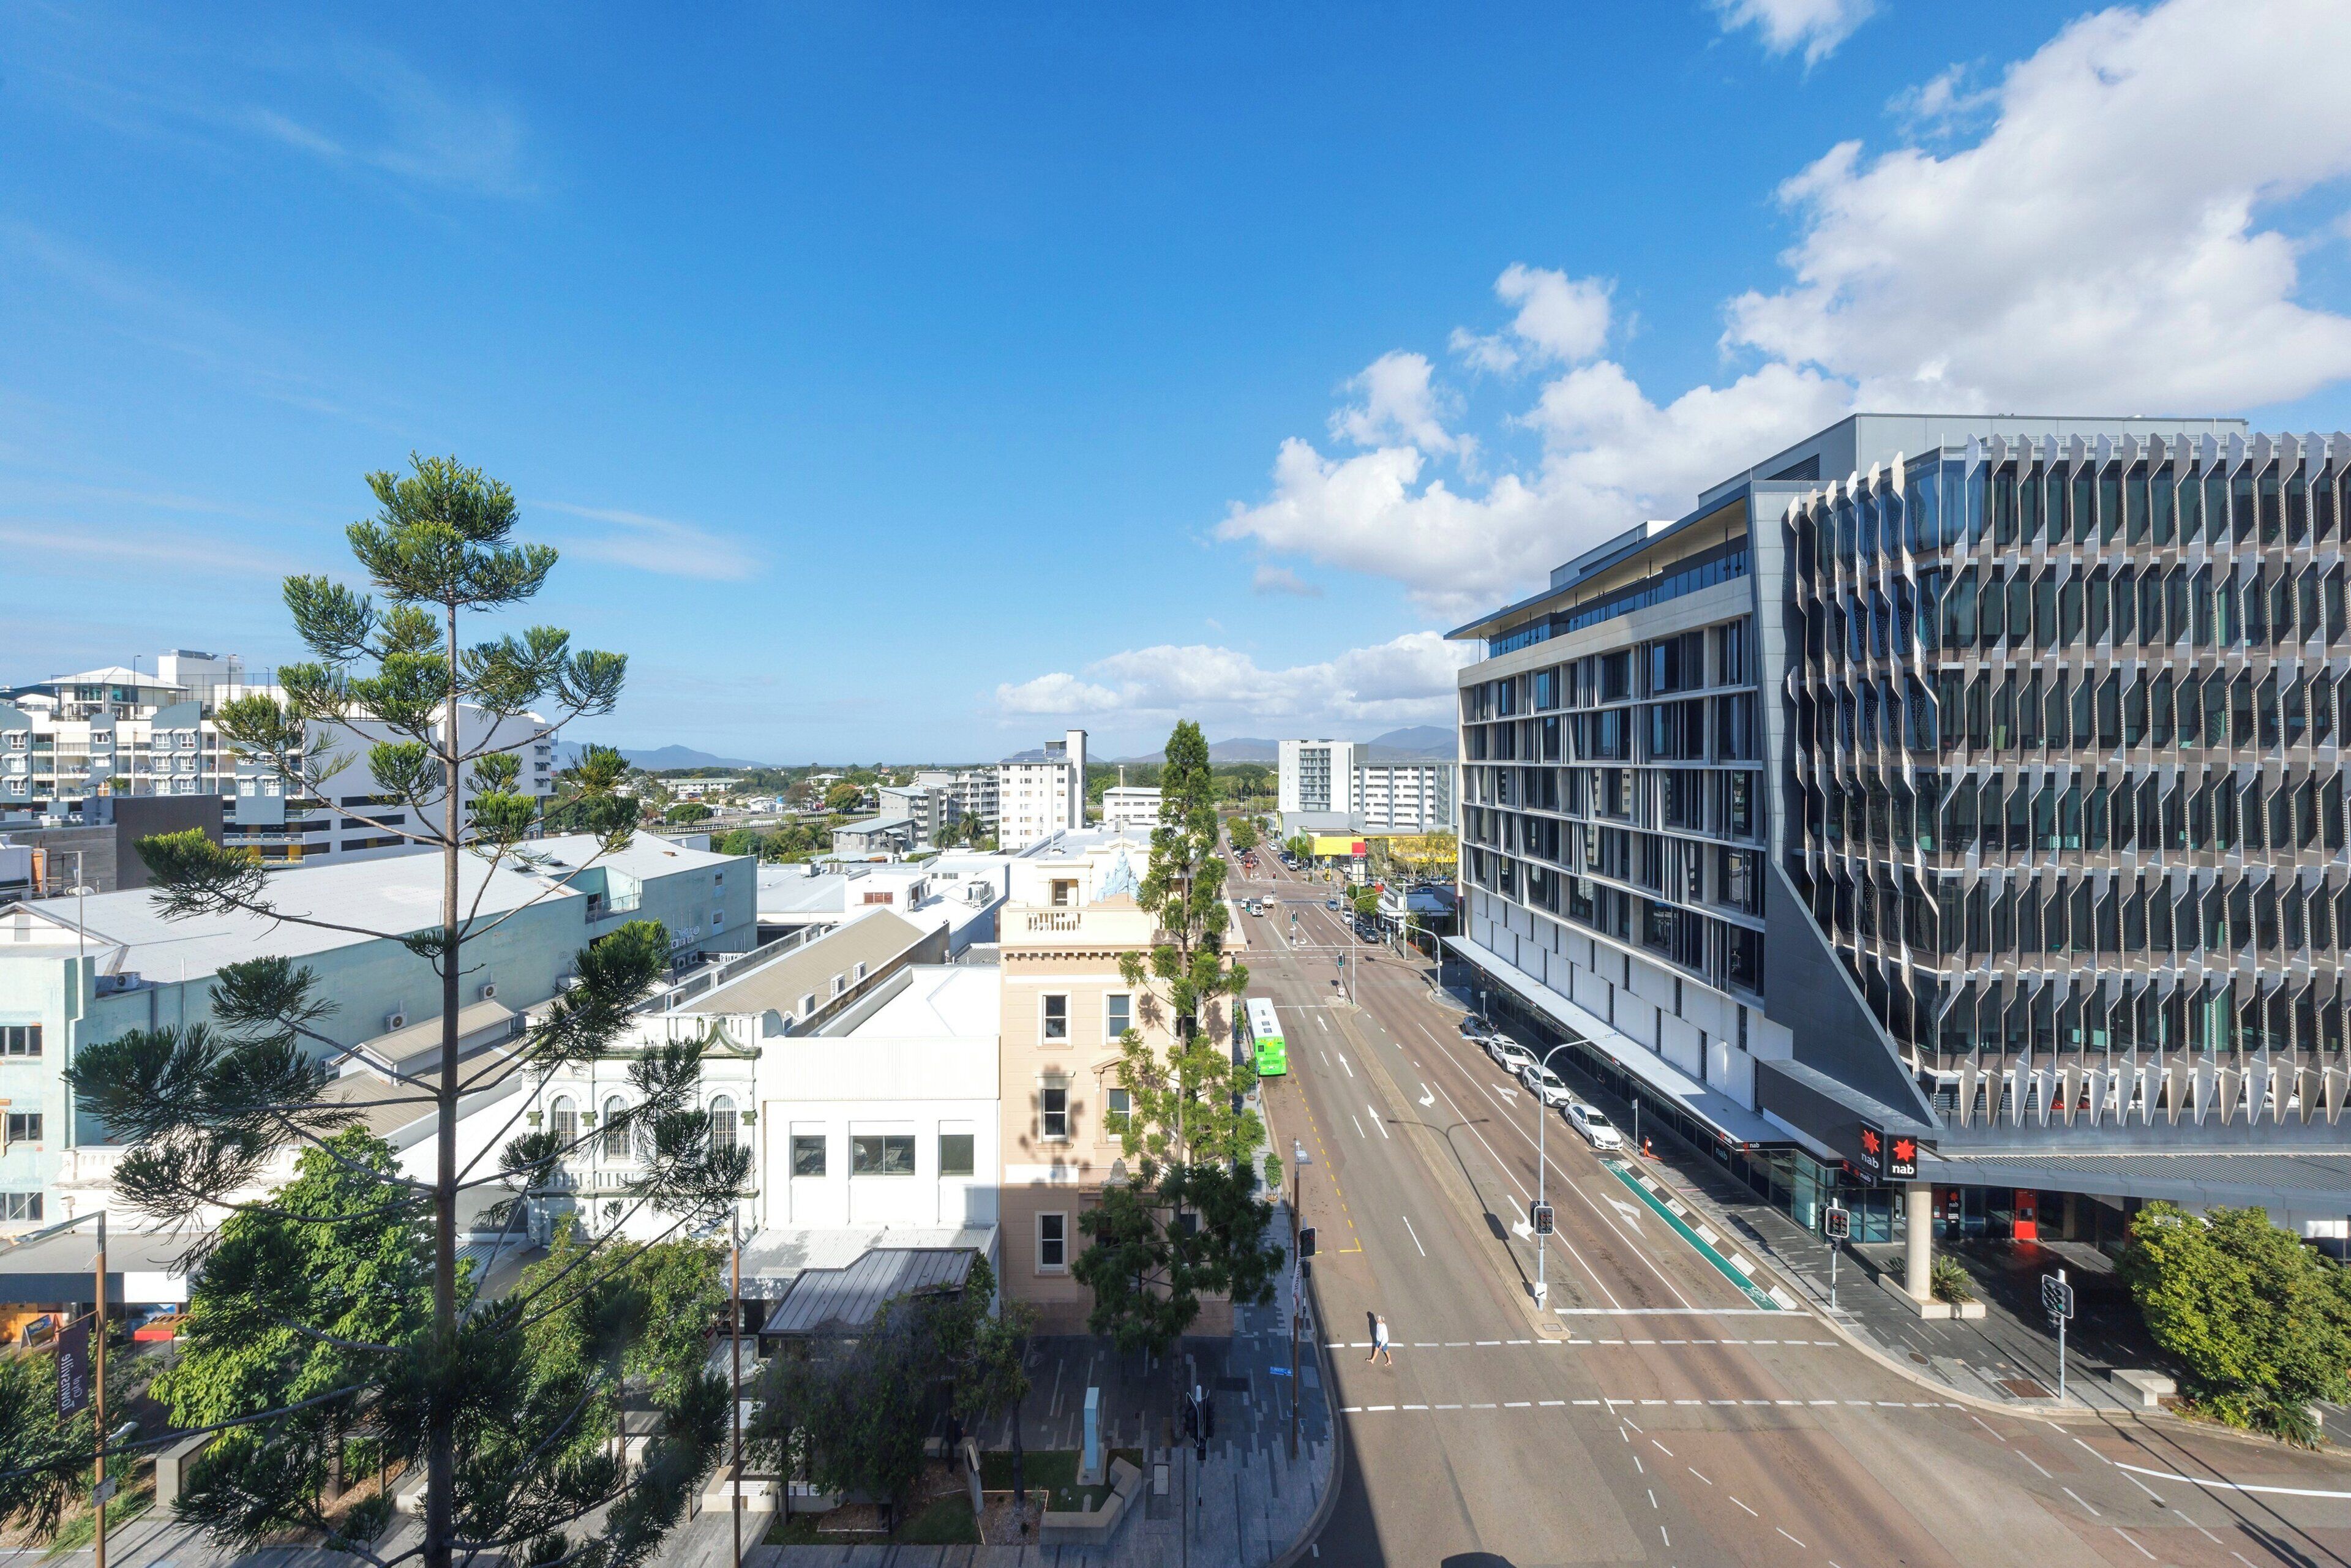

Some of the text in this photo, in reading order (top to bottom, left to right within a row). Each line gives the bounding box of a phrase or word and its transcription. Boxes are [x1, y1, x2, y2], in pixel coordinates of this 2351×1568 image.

[1724, 1135, 1733, 1144] nab
[1715, 1147, 1728, 1161] nab
[1861, 1153, 1879, 1169] nab
[1892, 1164, 1914, 1175] nab
[1859, 1172, 1871, 1182] nab
